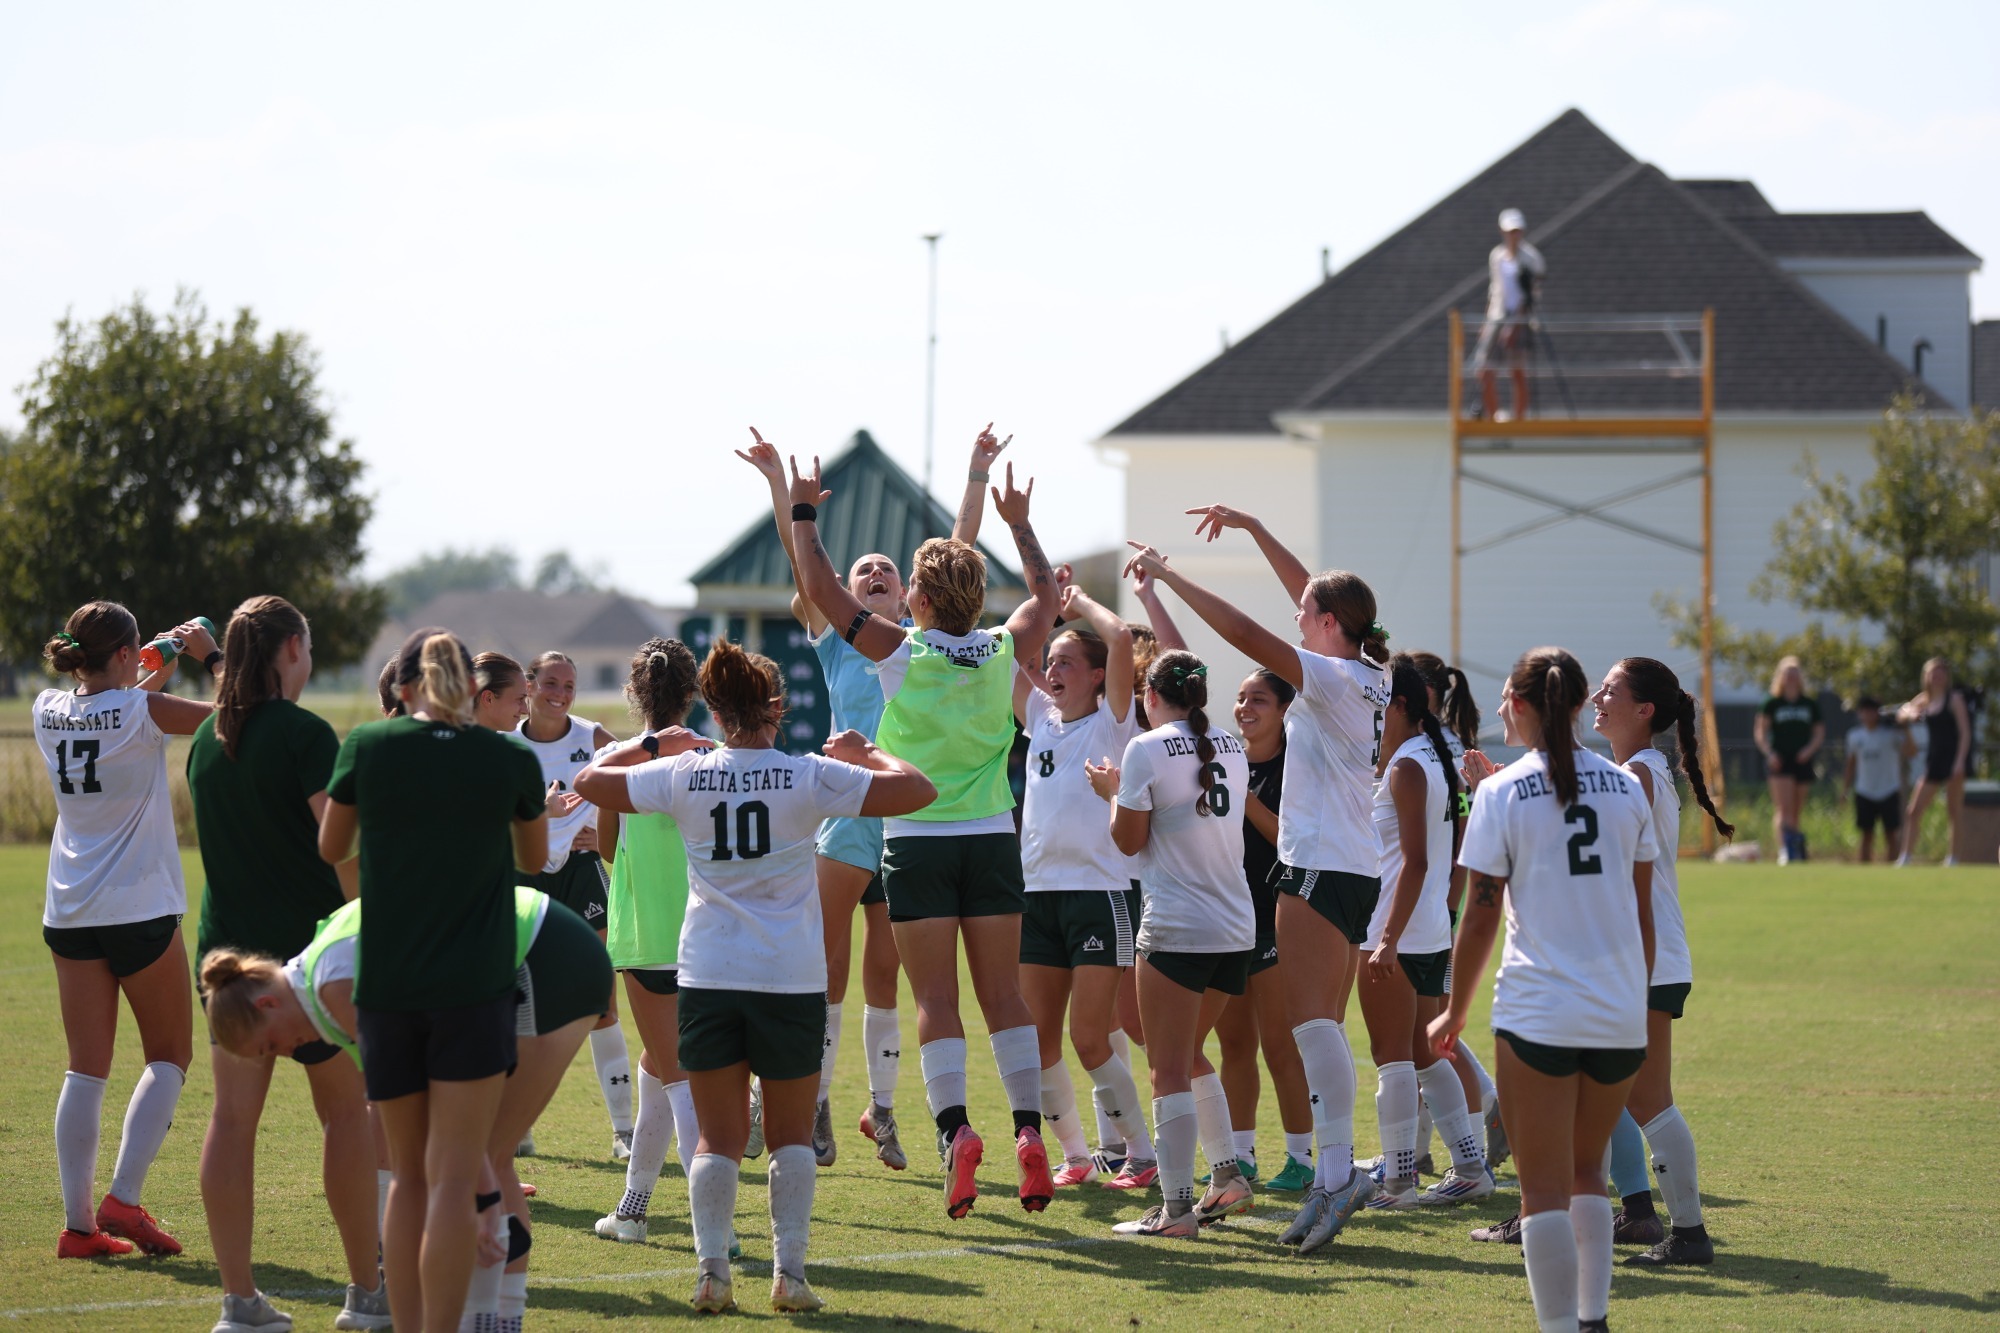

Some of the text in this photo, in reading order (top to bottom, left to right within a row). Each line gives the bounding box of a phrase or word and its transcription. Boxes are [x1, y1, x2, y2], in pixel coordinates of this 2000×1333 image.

[42, 708, 122, 731] DELTA STATE
[1163, 736, 1241, 757] DELT TATE
[56, 739, 102, 795] 17
[1039, 749, 1055, 778] 8
[688, 768, 793, 793] DELTA STATE
[1208, 762, 1230, 817] 6
[1514, 772, 1552, 800] DEL
[710, 800, 771, 861] 10
[1564, 804, 1603, 876] 2
